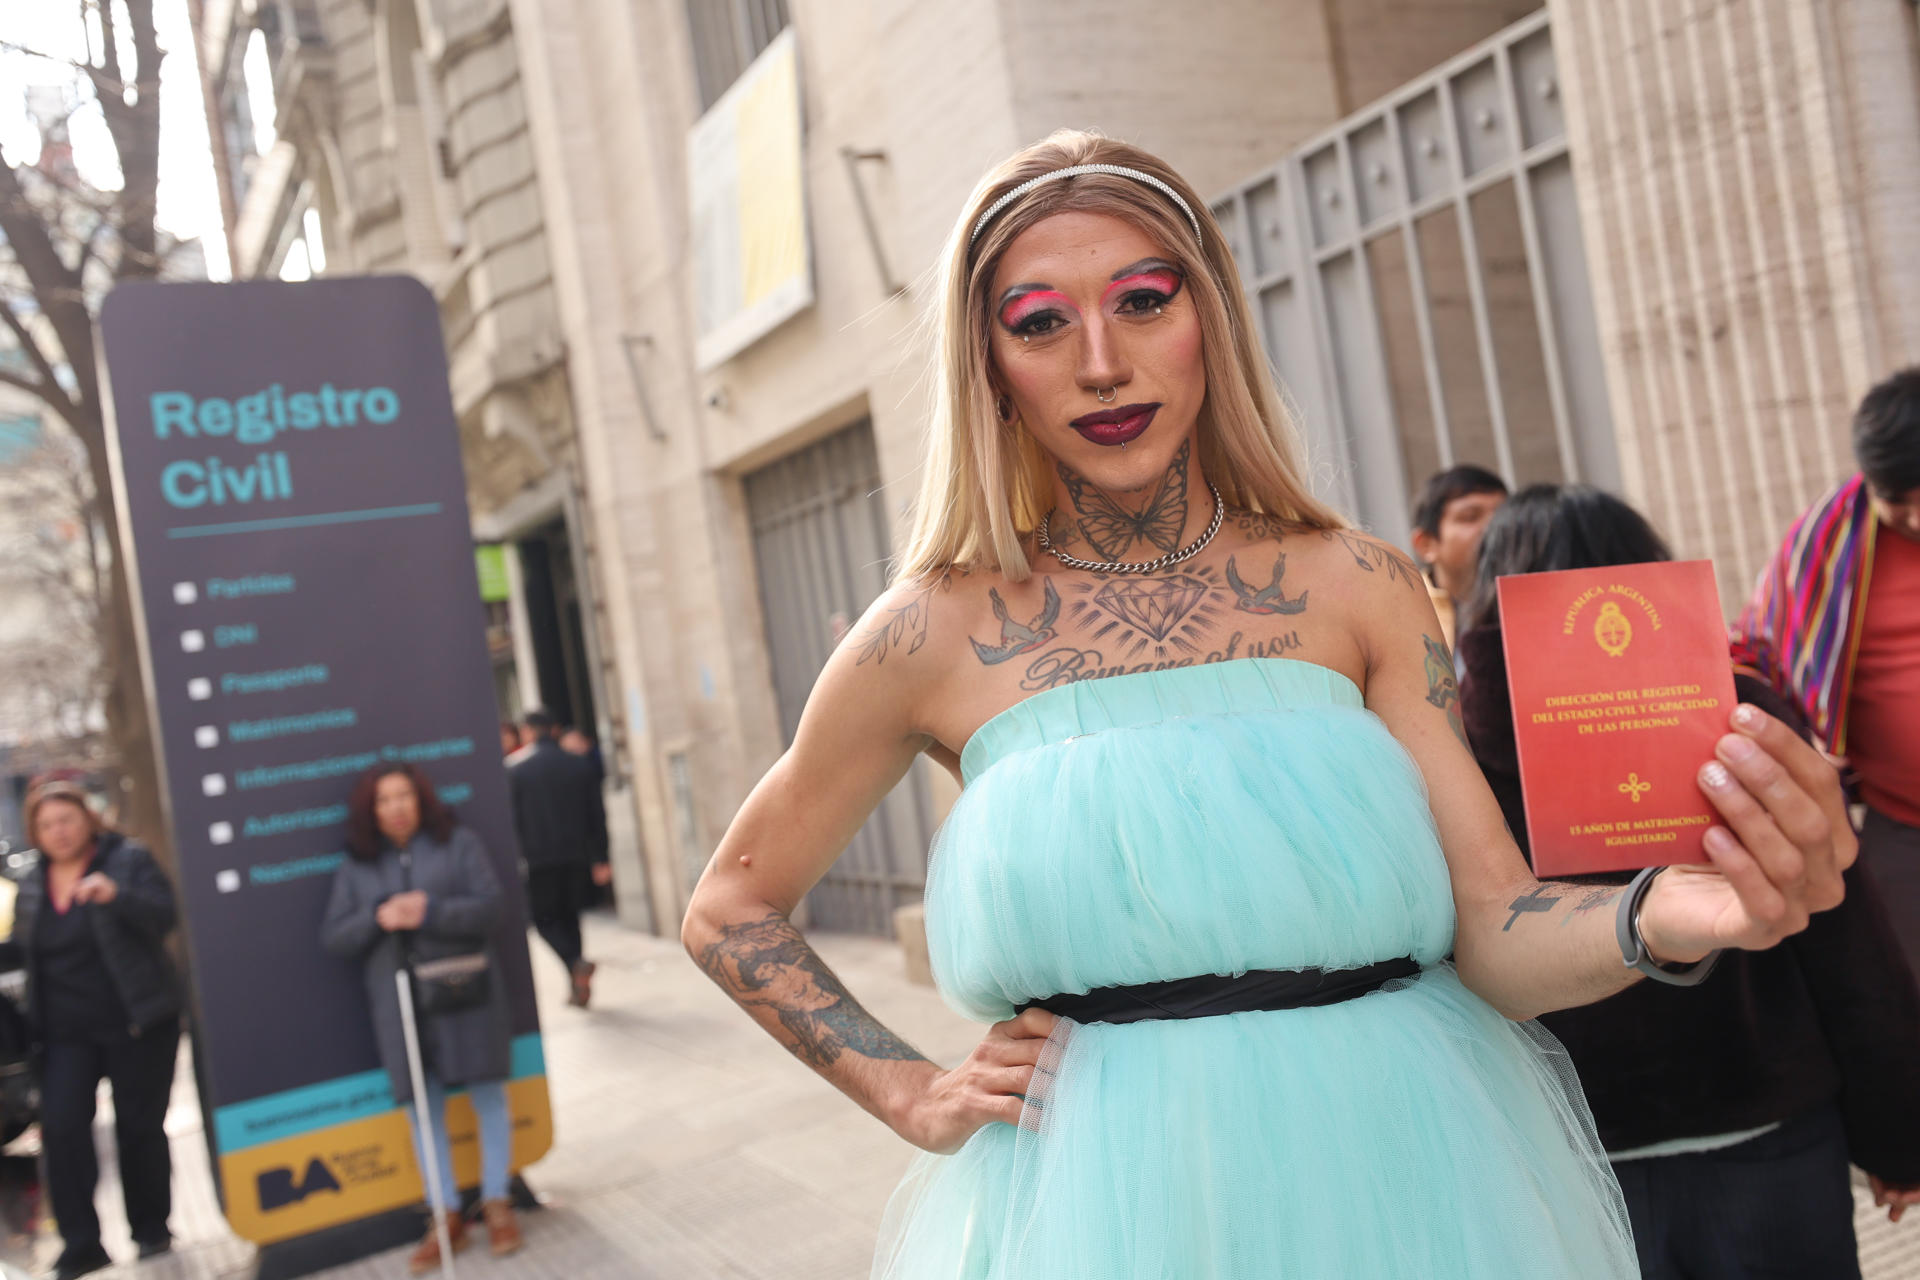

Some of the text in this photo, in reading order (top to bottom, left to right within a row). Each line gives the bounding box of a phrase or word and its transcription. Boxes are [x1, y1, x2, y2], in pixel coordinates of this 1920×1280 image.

[150, 382, 400, 444] Registro
[161, 451, 293, 509] Civil
[1608, 584, 1662, 631] ARGENTINA
[1205, 631, 1243, 662] of
[1246, 631, 1303, 659] you
[1616, 688, 1639, 701] DEL
[1641, 684, 1701, 698] REGISTRO
[1532, 698, 1719, 724] DEL ESTADO CIVIL Y CAPACIDAD
[1578, 716, 1680, 735] DE LAS PERSONAS
[1569, 825, 1582, 836] 15
[1616, 820, 1631, 832] DE
[1633, 815, 1711, 830] MATRIMONIO
[1605, 831, 1677, 847] IGUALITARIO
[257, 1155, 342, 1215] BA
